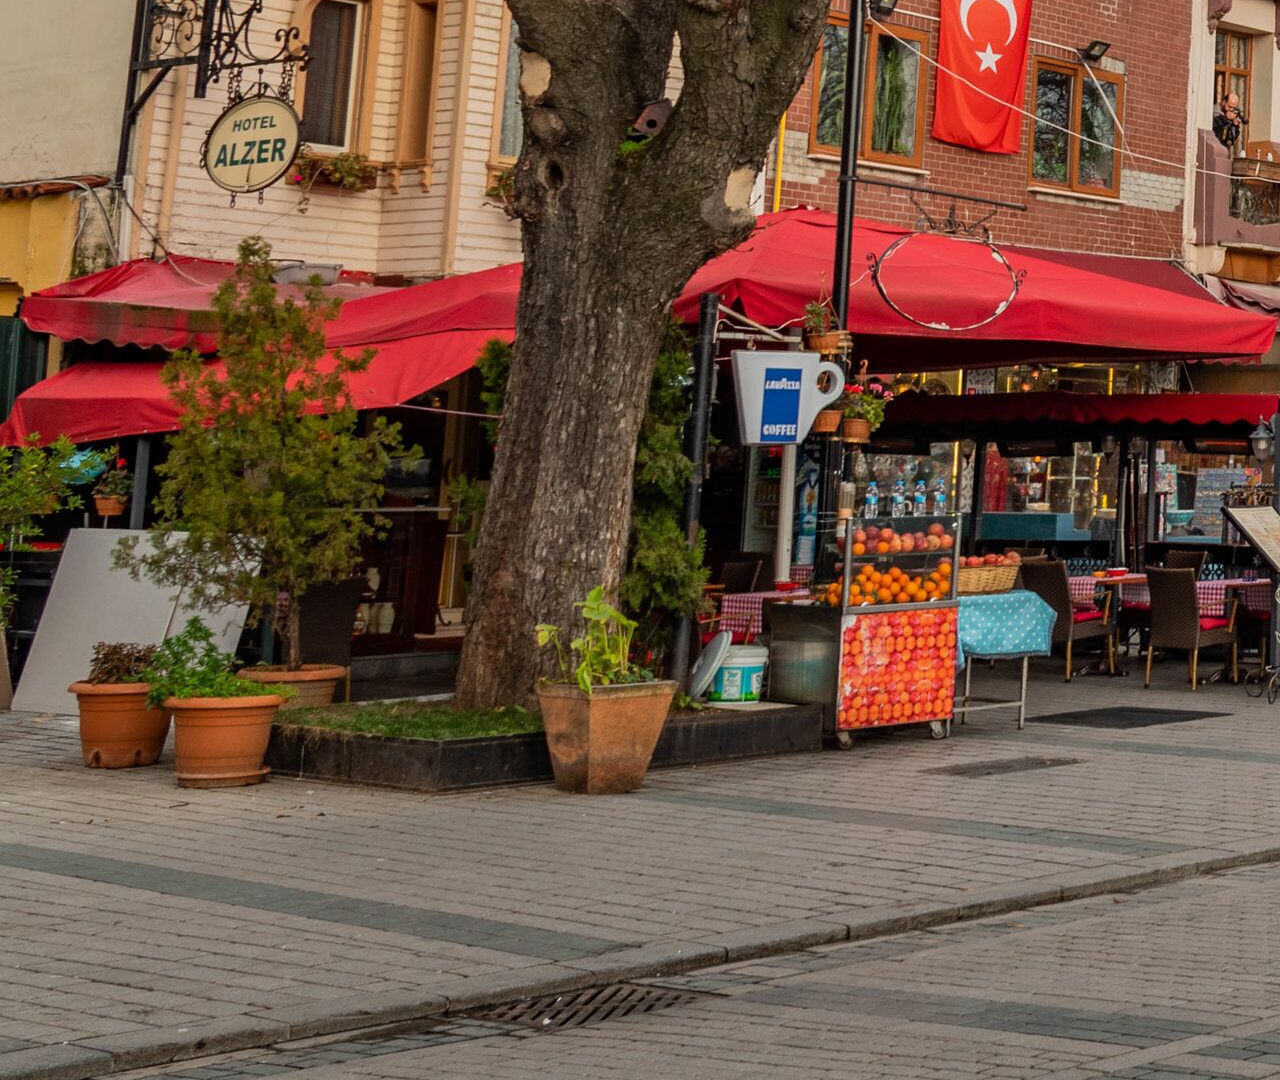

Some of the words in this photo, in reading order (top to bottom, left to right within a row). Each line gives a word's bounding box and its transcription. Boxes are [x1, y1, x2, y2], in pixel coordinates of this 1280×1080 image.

[232, 116, 276, 132] HOTEL
[214, 138, 286, 168] ALZER
[765, 377, 800, 390] LAVAZZA
[763, 424, 797, 436] COFFEE
